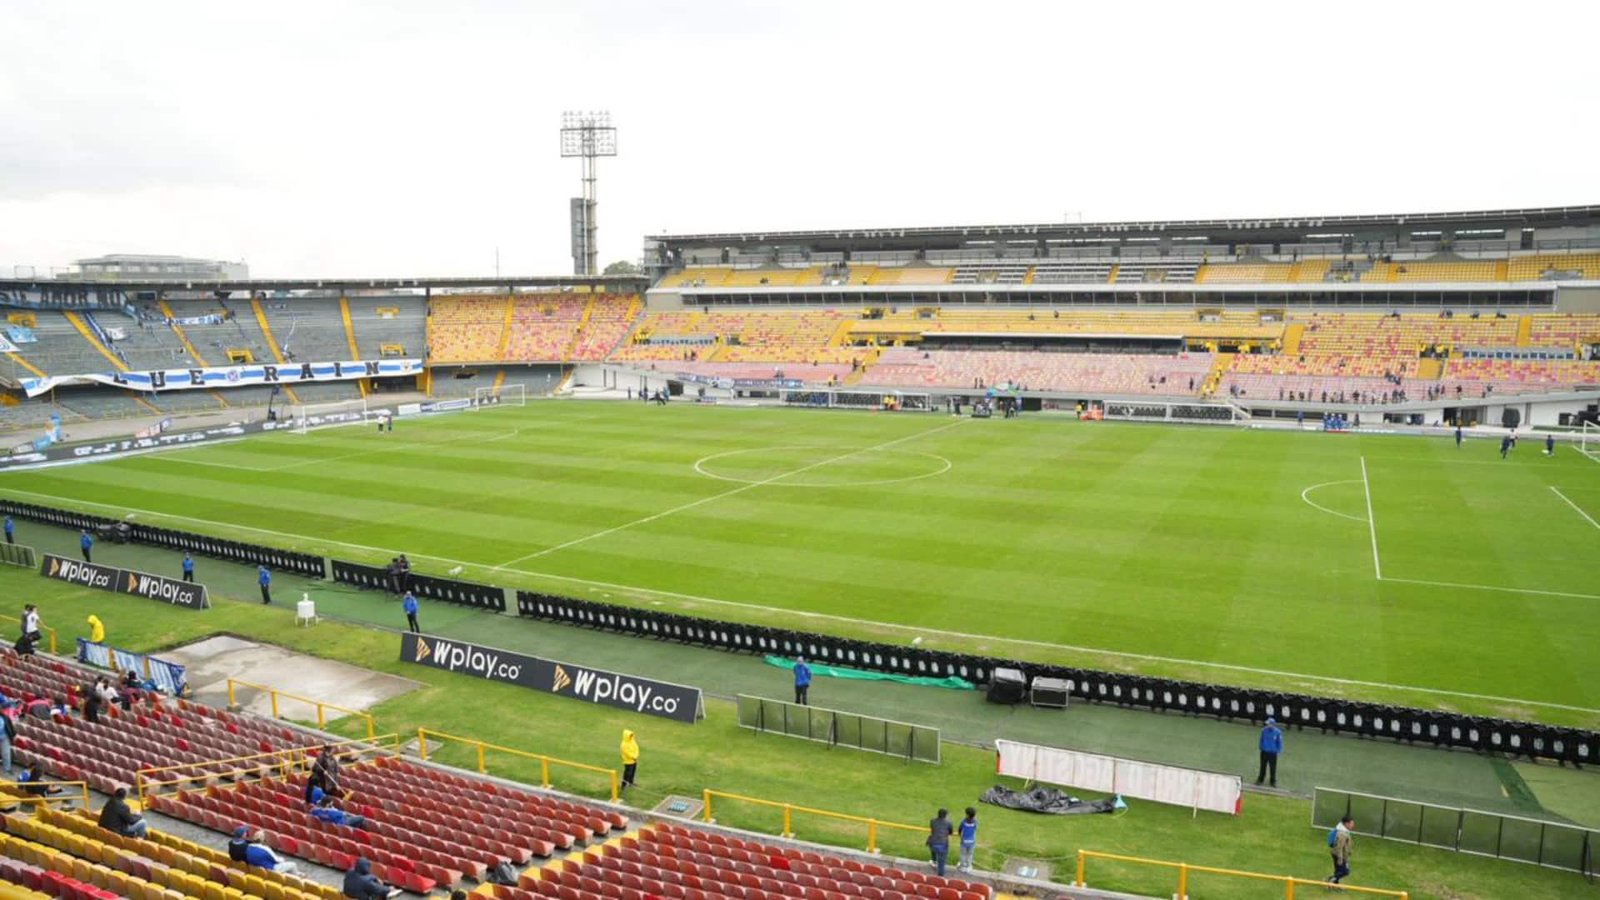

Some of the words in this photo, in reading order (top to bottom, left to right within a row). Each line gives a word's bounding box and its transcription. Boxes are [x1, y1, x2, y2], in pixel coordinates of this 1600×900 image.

[113, 369, 205, 388] LUE
[263, 361, 380, 381] RAIN
[59, 559, 109, 587] Wplay.co
[138, 575, 193, 604] Wplay.co
[433, 640, 520, 679] Wplay.co
[574, 669, 677, 712] Wplay.co
